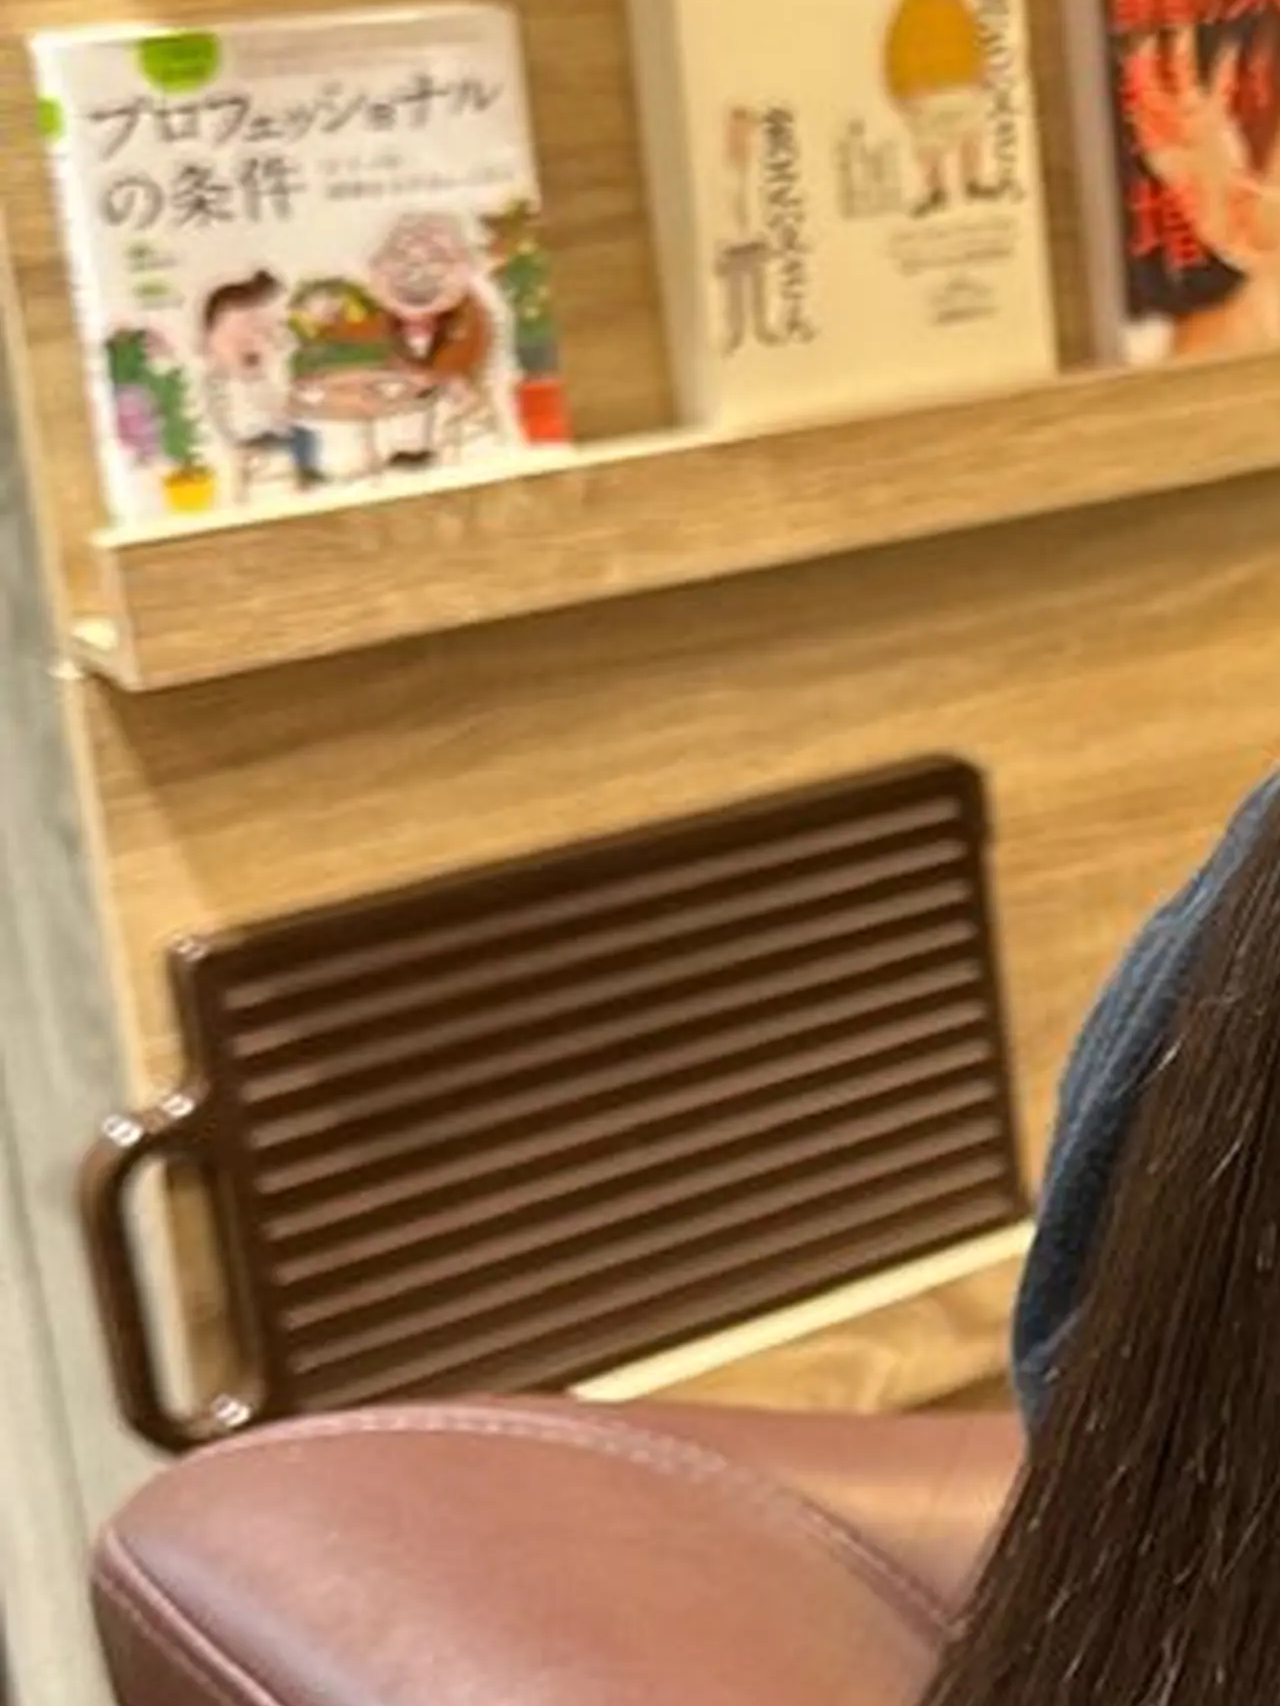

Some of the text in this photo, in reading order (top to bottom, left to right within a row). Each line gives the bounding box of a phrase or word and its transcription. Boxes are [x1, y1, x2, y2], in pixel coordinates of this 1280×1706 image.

[88, 73, 506, 160] プロフェッショナル
[103, 154, 306, 230] の条件
